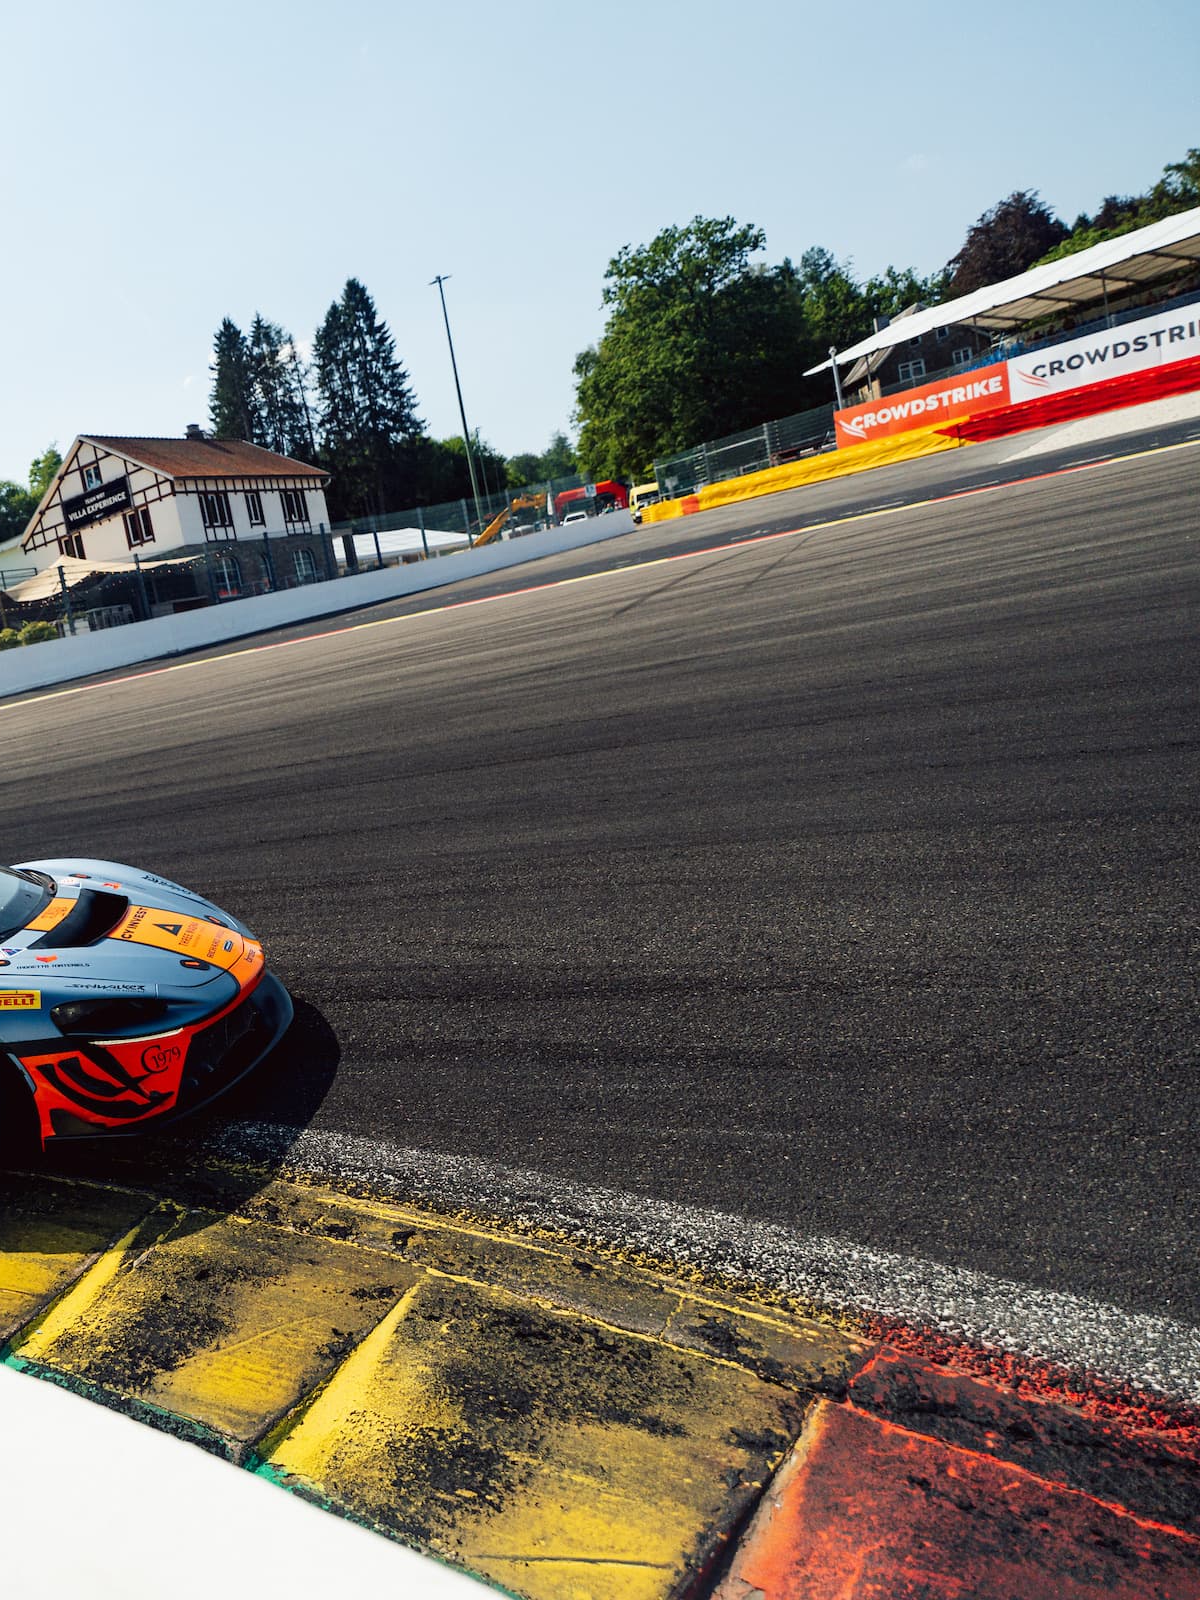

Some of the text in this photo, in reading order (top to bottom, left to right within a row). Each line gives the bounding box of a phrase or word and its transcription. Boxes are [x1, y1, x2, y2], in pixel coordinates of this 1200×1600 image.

[1032, 320, 1200, 378] CROWDSTRI
[851, 376, 1003, 430] CROWDSTRIKE
[68, 491, 127, 521] VILLA EXPERIENCE
[121, 907, 147, 939] CY INVEST
[152, 1046, 181, 1068] 1979
